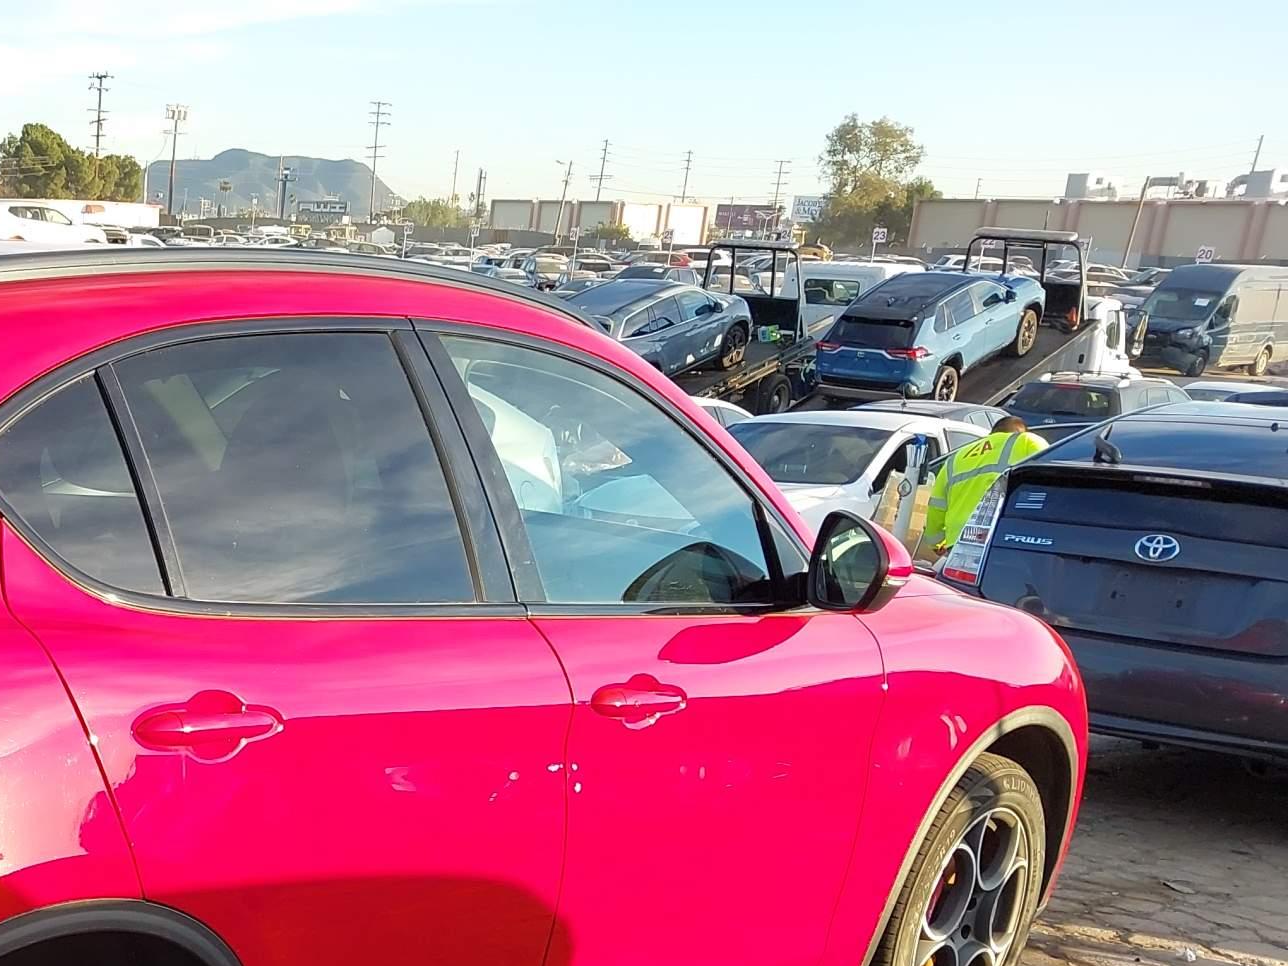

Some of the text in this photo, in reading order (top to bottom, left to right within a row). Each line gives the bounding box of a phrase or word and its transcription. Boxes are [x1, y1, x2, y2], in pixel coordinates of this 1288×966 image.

[873, 231, 886, 240] 23
[1199, 249, 1212, 259] 20
[1004, 534, 1053, 546] PRIUS
